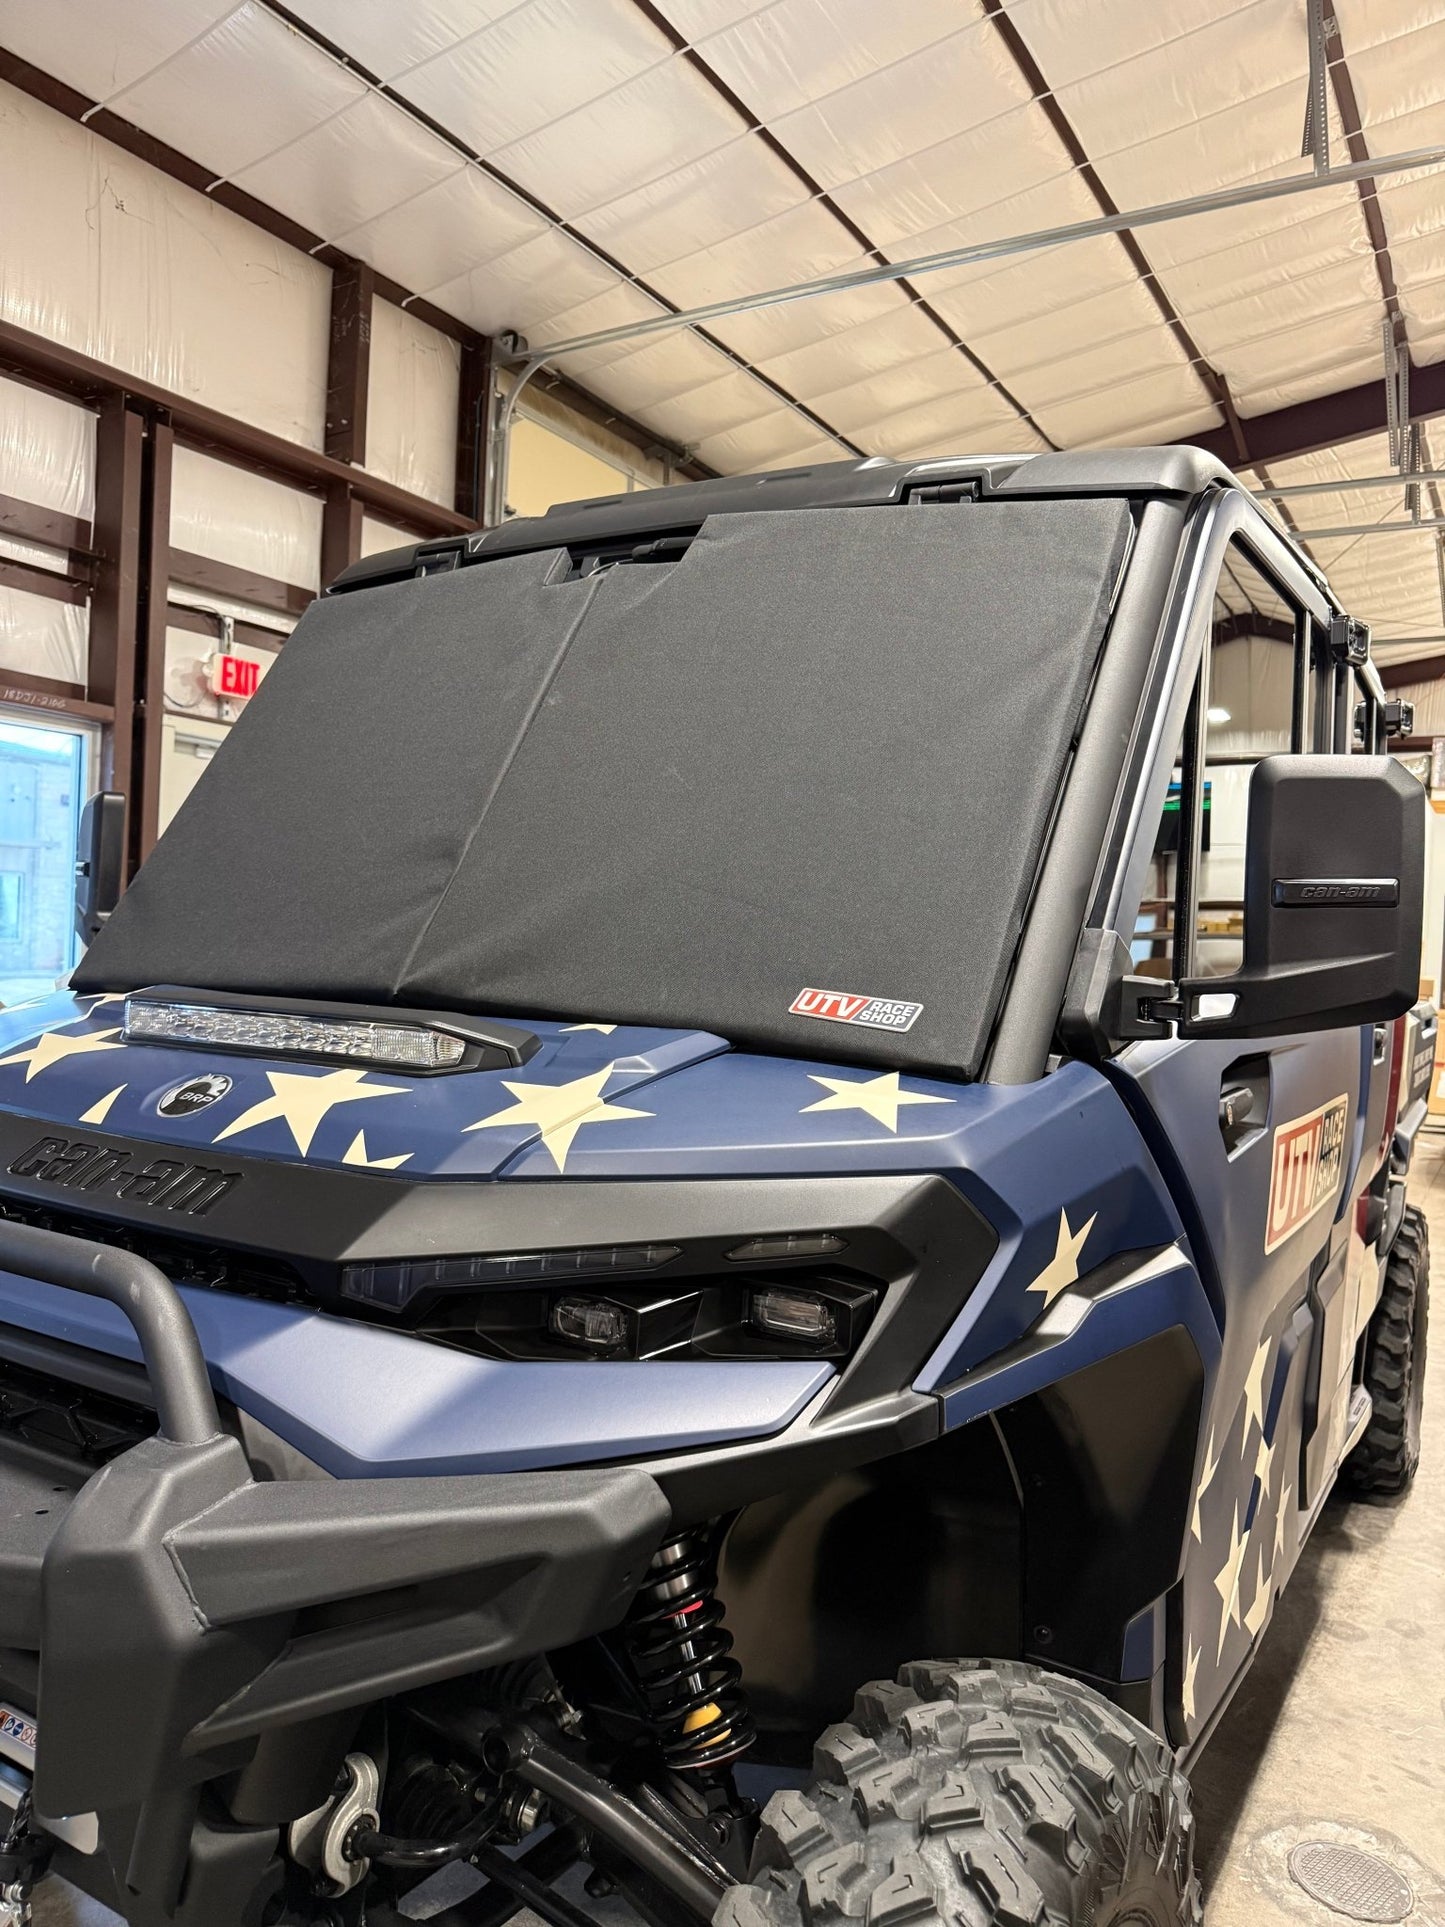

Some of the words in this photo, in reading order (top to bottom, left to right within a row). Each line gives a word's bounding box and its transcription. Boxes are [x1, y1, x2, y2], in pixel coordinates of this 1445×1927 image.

[222, 656, 260, 696] EXIT
[1300, 886, 1381, 898] can-am
[797, 991, 863, 1017] UTV
[869, 1001, 915, 1017] RACE
[859, 1009, 907, 1026] SHOP
[179, 1091, 214, 1104] BRP
[1321, 1108, 1345, 1158] RACE
[7, 1136, 245, 1217] can-am
[1272, 1123, 1322, 1232] UTV
